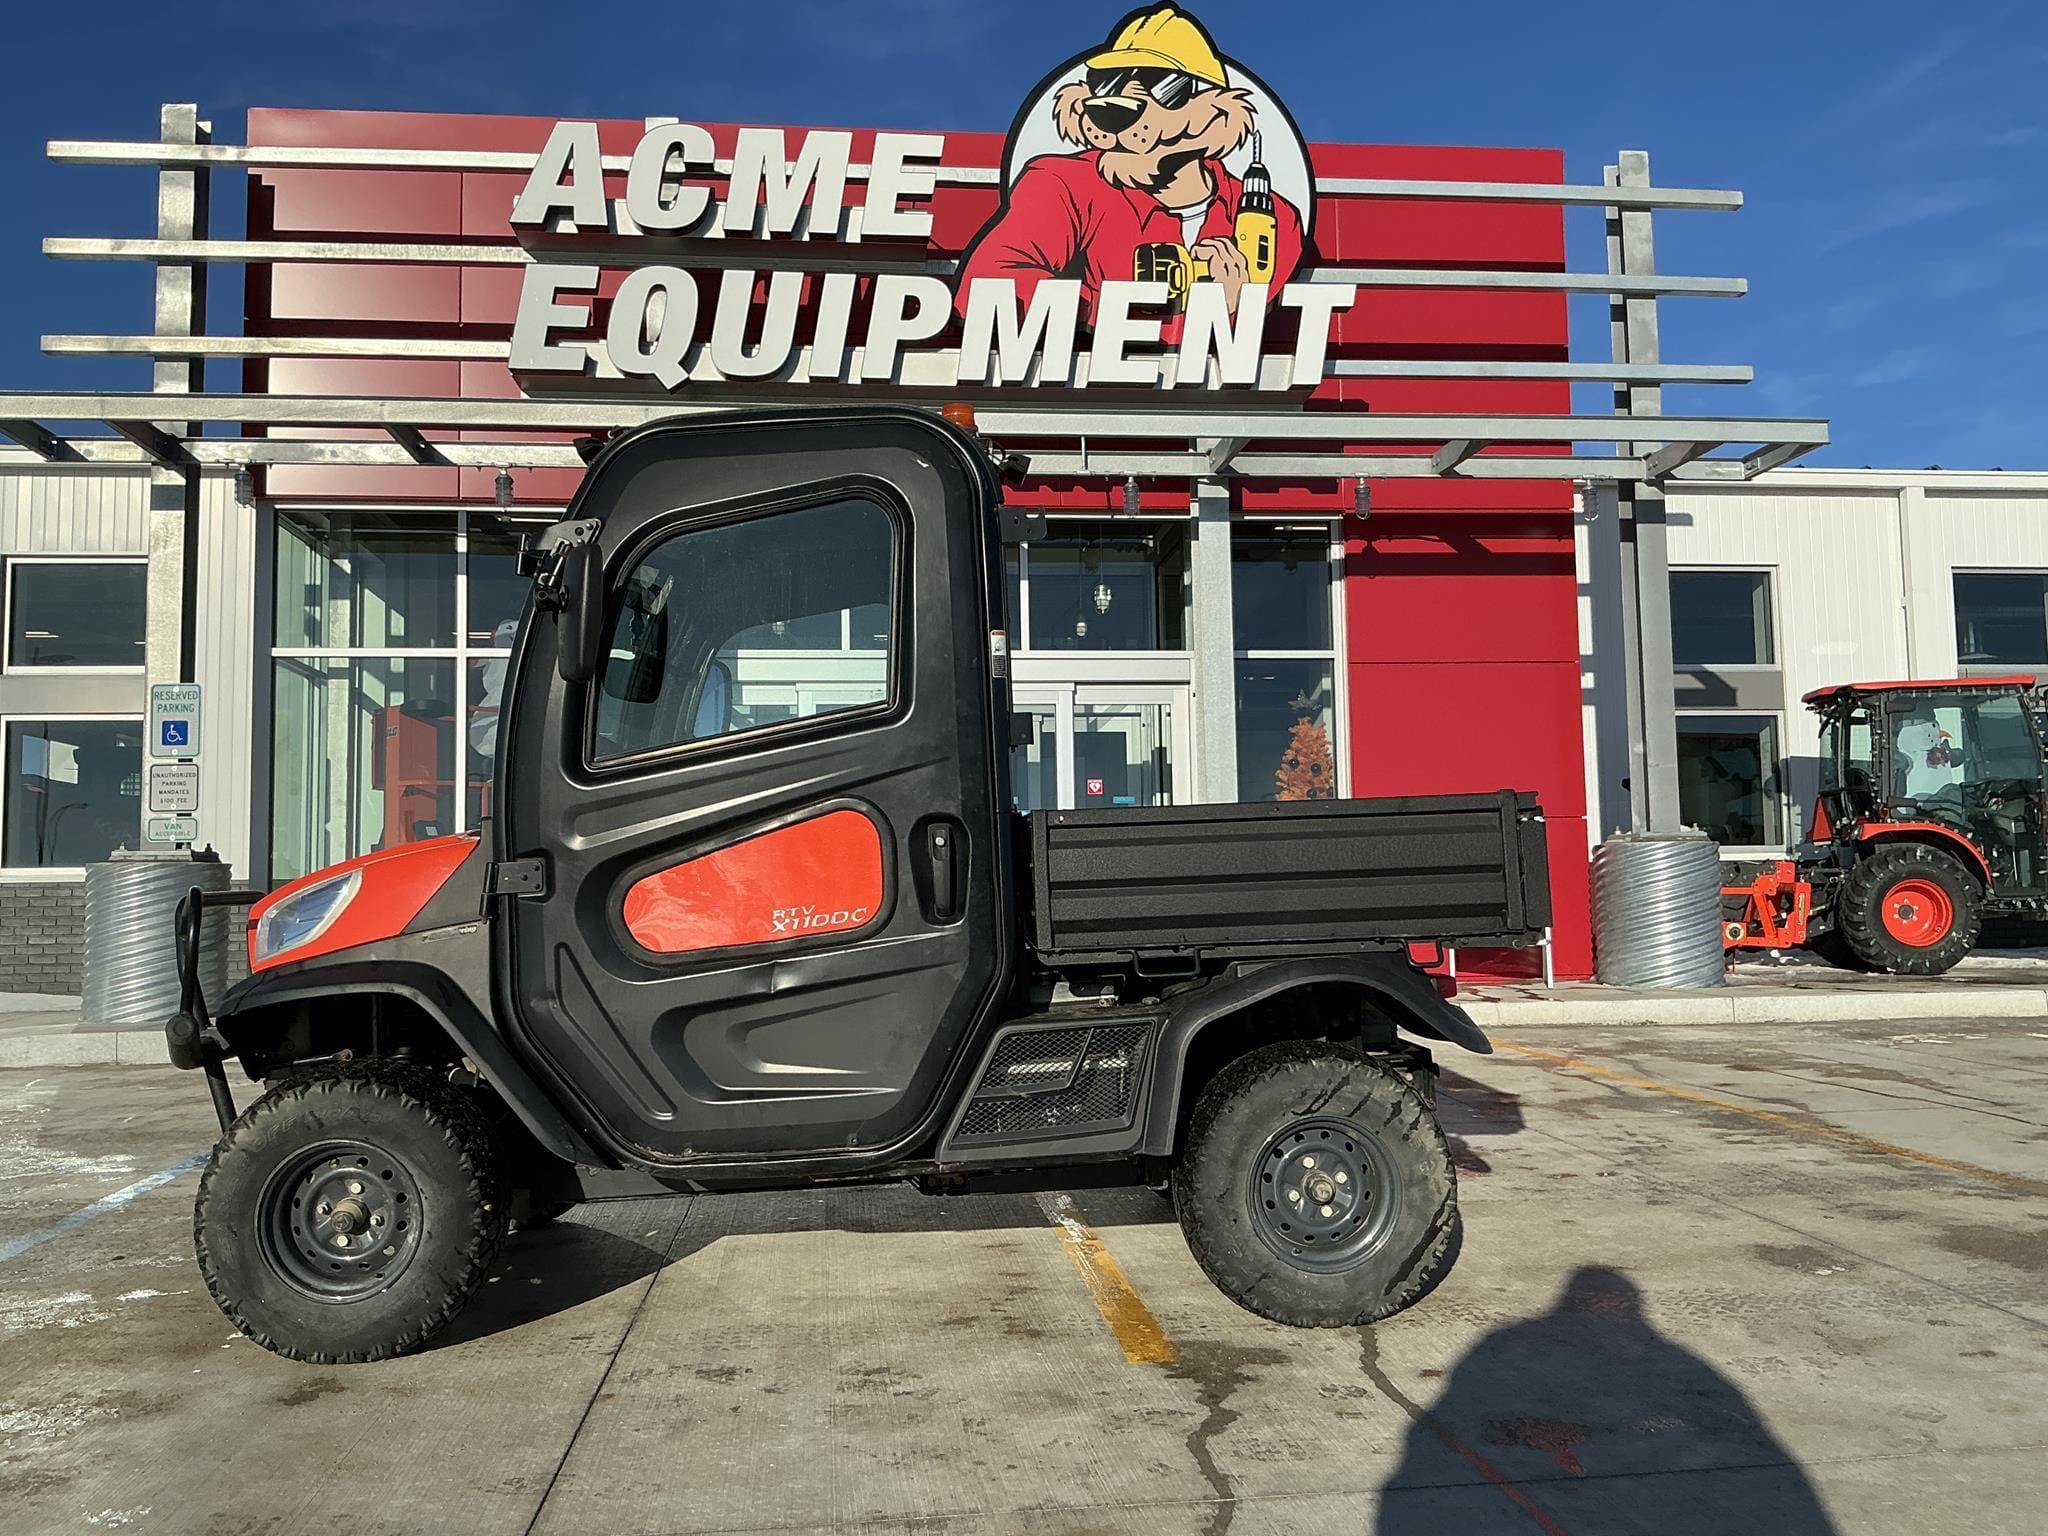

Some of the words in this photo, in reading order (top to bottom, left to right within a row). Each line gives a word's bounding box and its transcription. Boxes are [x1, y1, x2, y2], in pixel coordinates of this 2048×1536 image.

[509, 121, 945, 237] ACME
[509, 263, 1356, 391] EQUIPMENT
[154, 690, 199, 700] RESERVED
[157, 703, 195, 713] PARKING
[771, 907, 868, 933] X1100C
[772, 905, 816, 919] RTV
